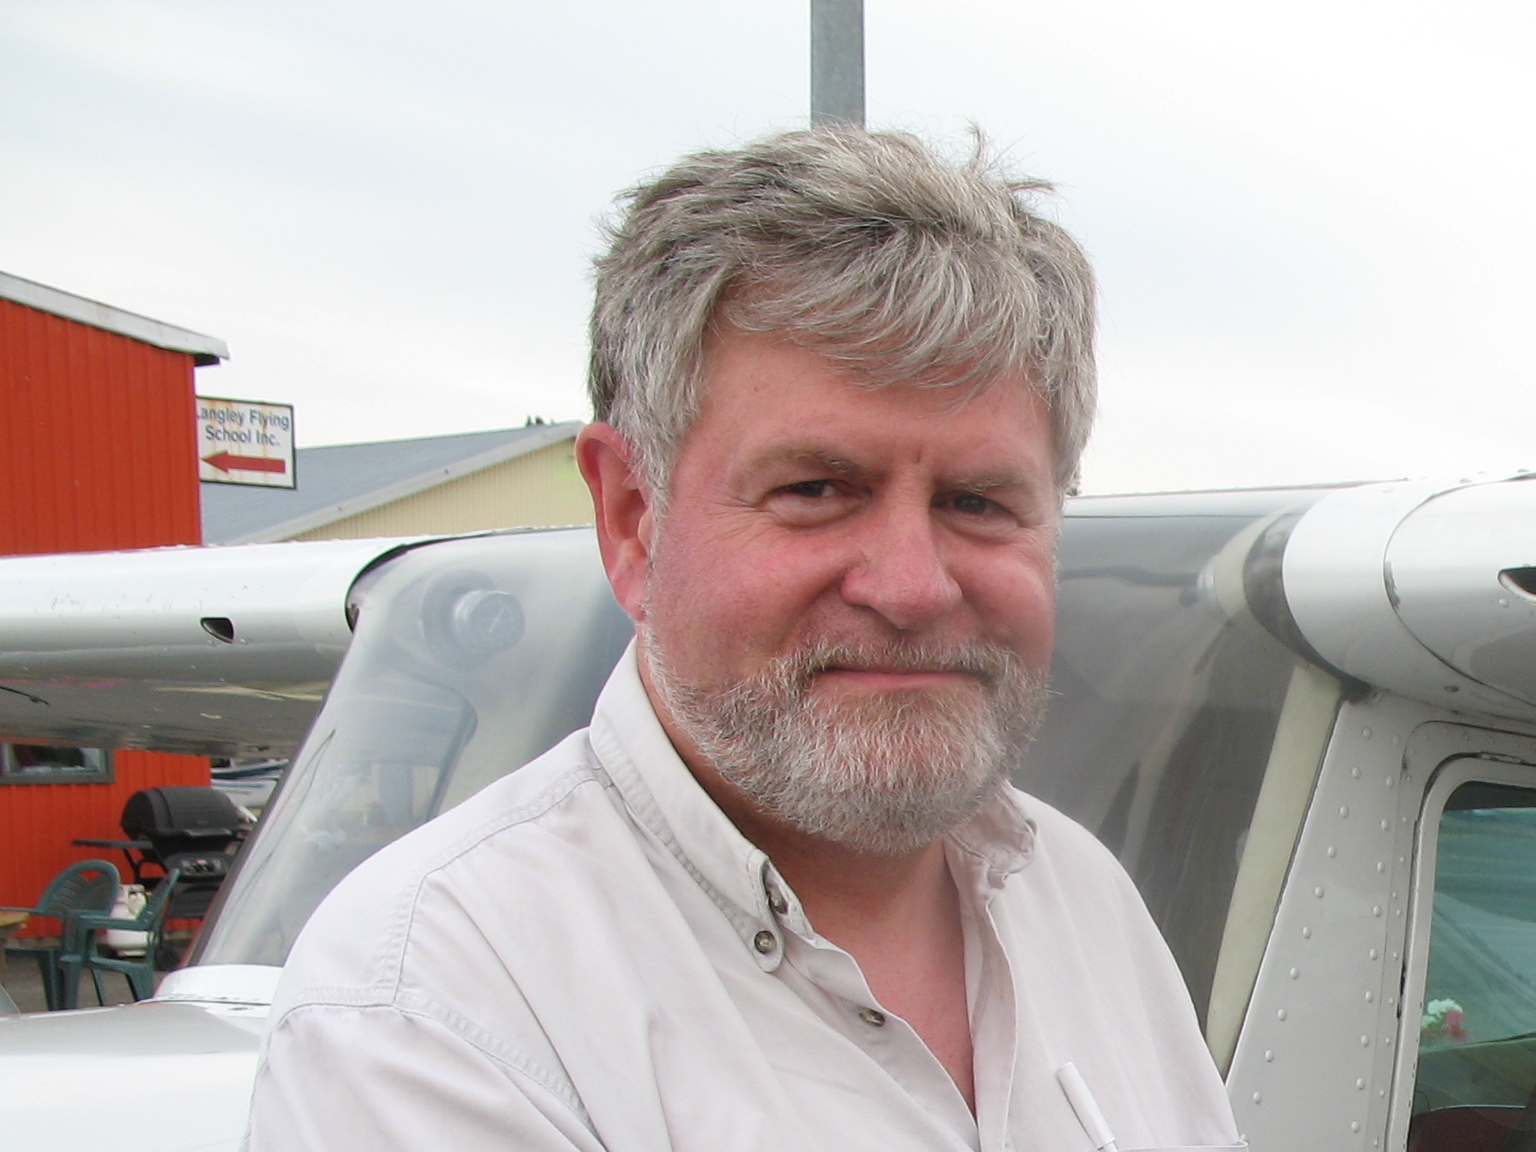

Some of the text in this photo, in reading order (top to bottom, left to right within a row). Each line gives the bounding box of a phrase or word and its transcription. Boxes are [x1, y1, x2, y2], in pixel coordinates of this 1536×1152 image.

[197, 406, 290, 432] angley Flying
[205, 424, 280, 446] School Inc.
